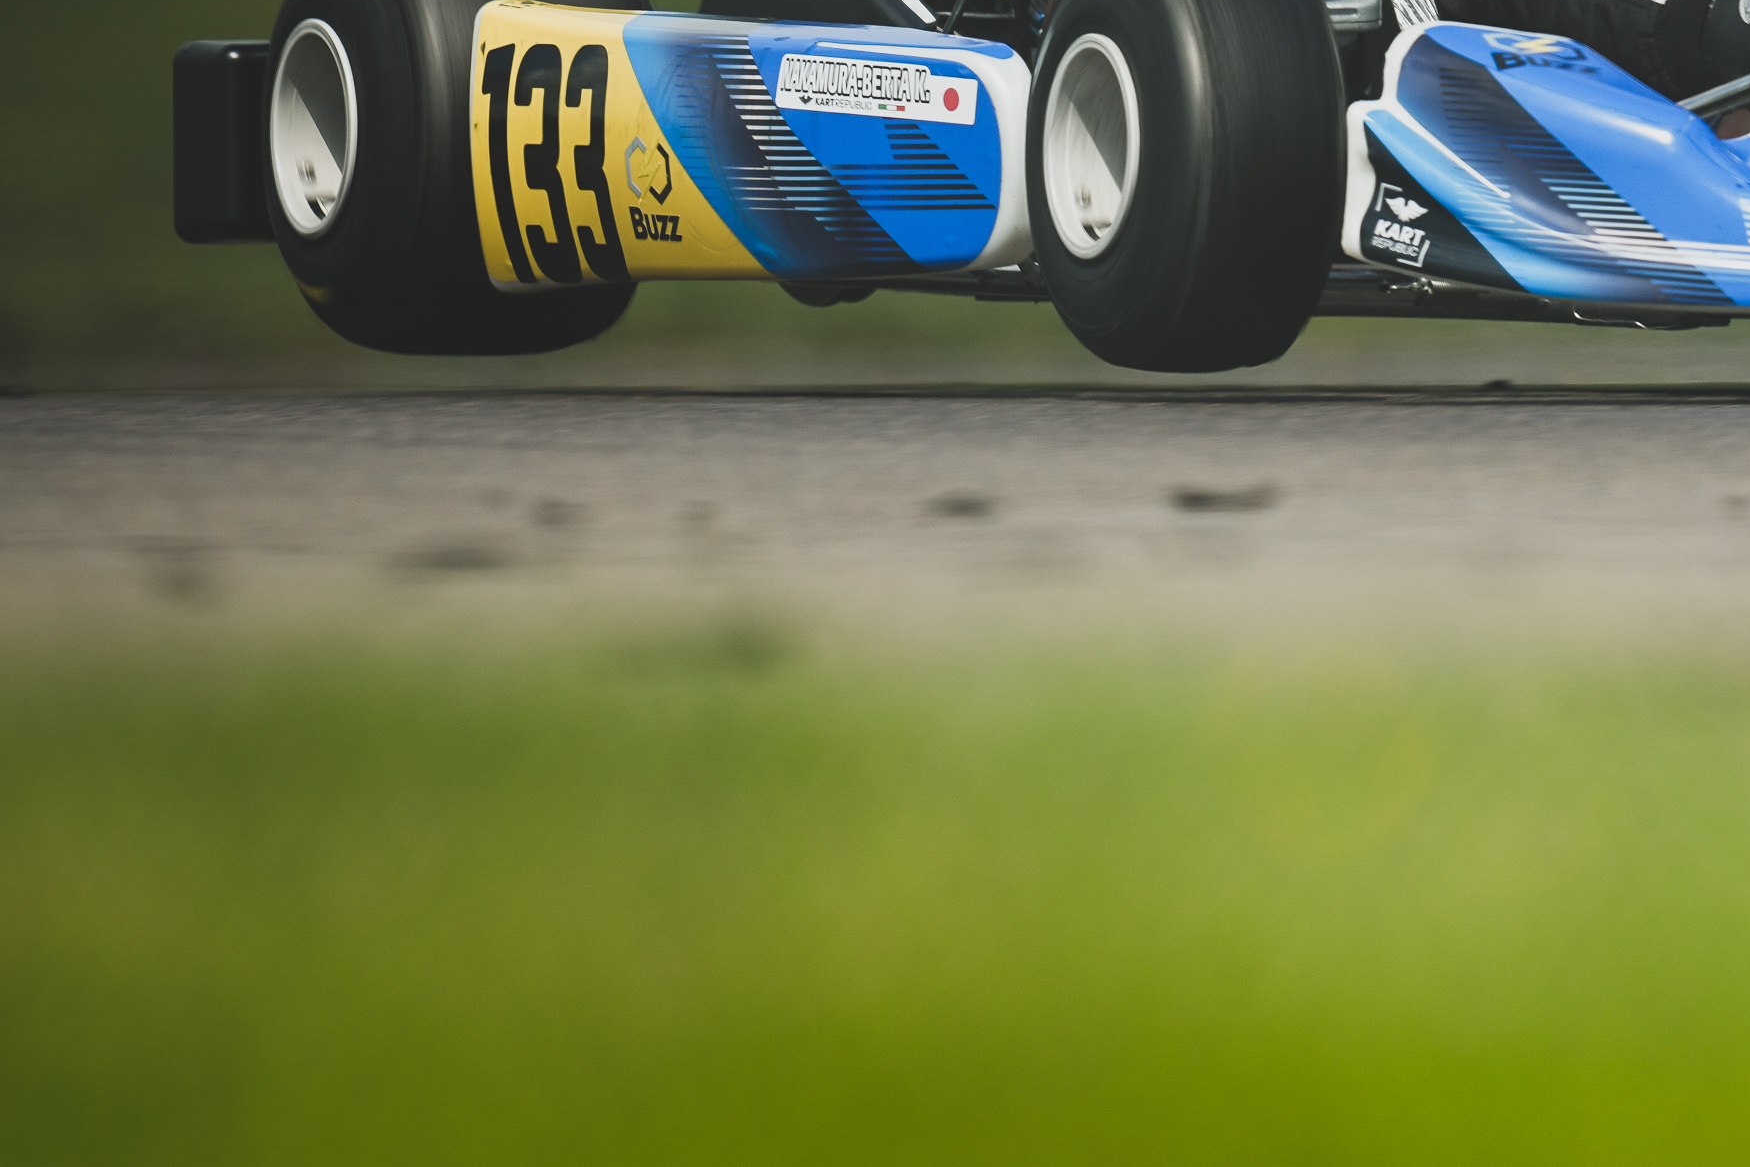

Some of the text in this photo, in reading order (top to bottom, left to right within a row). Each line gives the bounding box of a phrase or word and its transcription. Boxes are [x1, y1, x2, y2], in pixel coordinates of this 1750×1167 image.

[780, 57, 931, 103] NAKAMURA-BERTA K.
[481, 42, 633, 284] 133
[1374, 218, 1426, 246] KART
